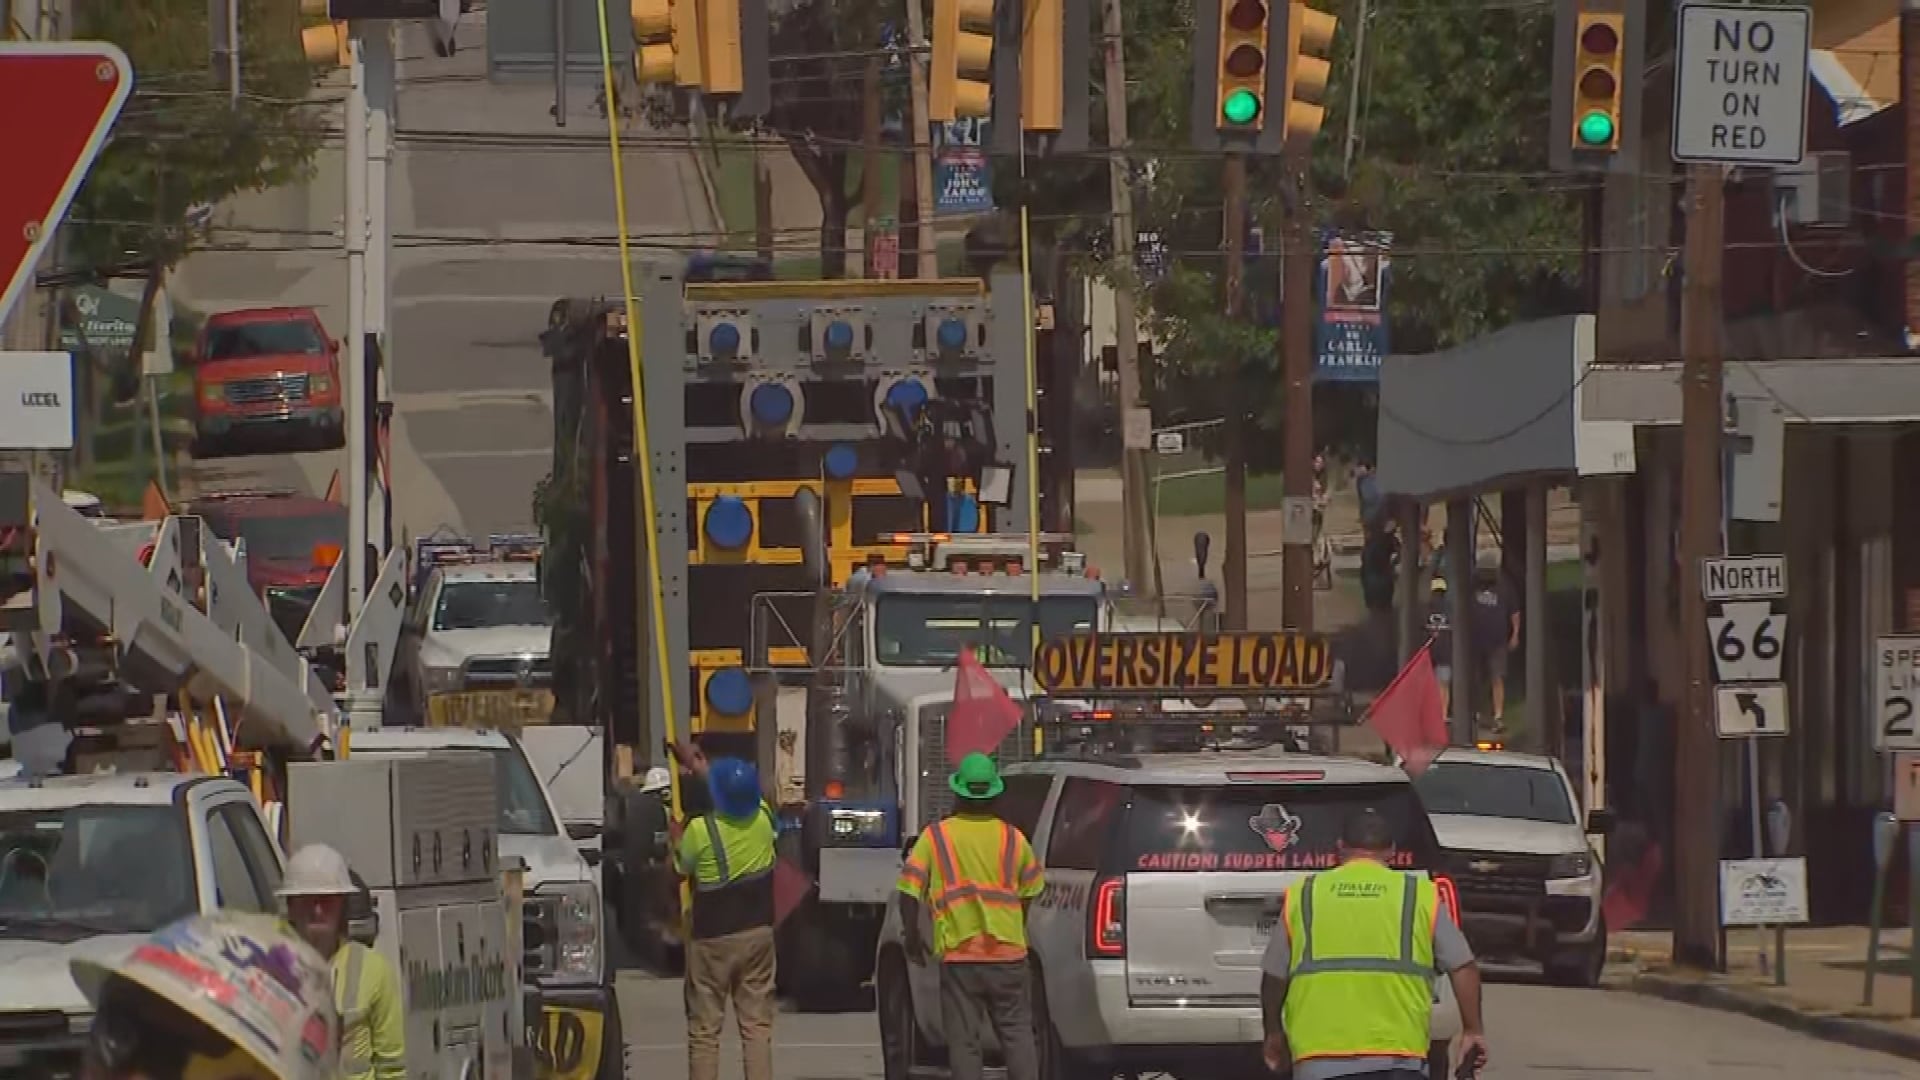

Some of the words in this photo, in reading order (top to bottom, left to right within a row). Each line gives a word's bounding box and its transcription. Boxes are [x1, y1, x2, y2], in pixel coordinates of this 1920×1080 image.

[1714, 18, 1775, 53] NO
[1706, 59, 1780, 85] TURN
[1722, 91, 1760, 117] ON
[1711, 124, 1767, 149] RED
[1327, 340, 1363, 352] CARL
[1710, 565, 1781, 591] NORTH
[1716, 618, 1781, 662] 66
[1046, 634, 1221, 688] OVERSIZE
[1231, 634, 1326, 686] LOAD
[1224, 853, 1287, 868] SUDDEN
